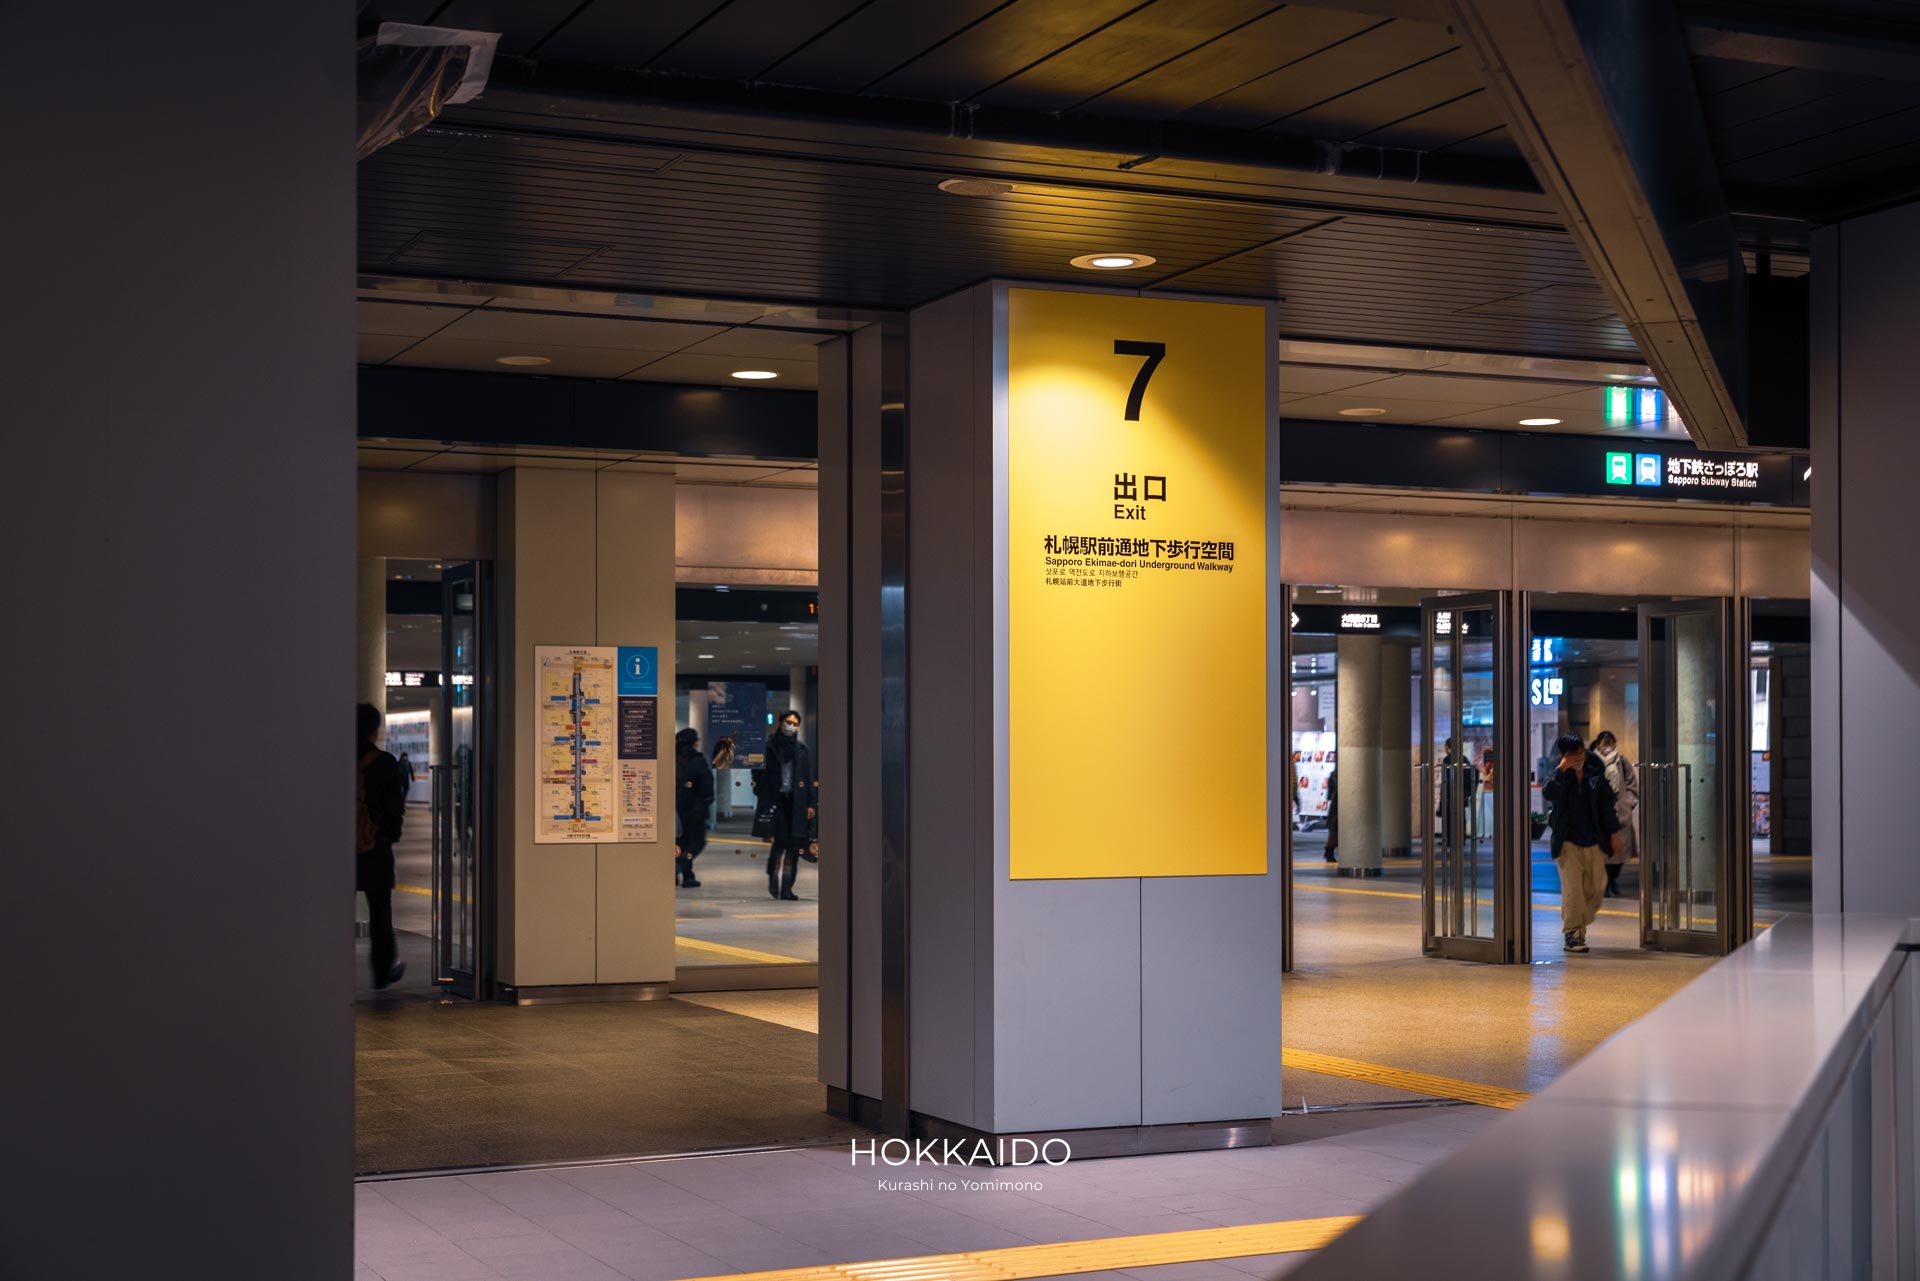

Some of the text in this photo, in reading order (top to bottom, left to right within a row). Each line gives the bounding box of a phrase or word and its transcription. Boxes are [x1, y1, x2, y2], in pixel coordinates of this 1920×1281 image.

[1114, 339, 1166, 422] 7
[1667, 457, 1758, 477] 地下鉄さっぽろ駅
[1114, 472, 1166, 501] 出口
[1667, 474, 1757, 488] Sapporo Subway Station
[1114, 504, 1146, 520] Exit
[1044, 534, 1234, 561] 札幌駅前通地下歩行空間
[1045, 556, 1234, 573] Sapporo Ekimae-dori Underground Walkway
